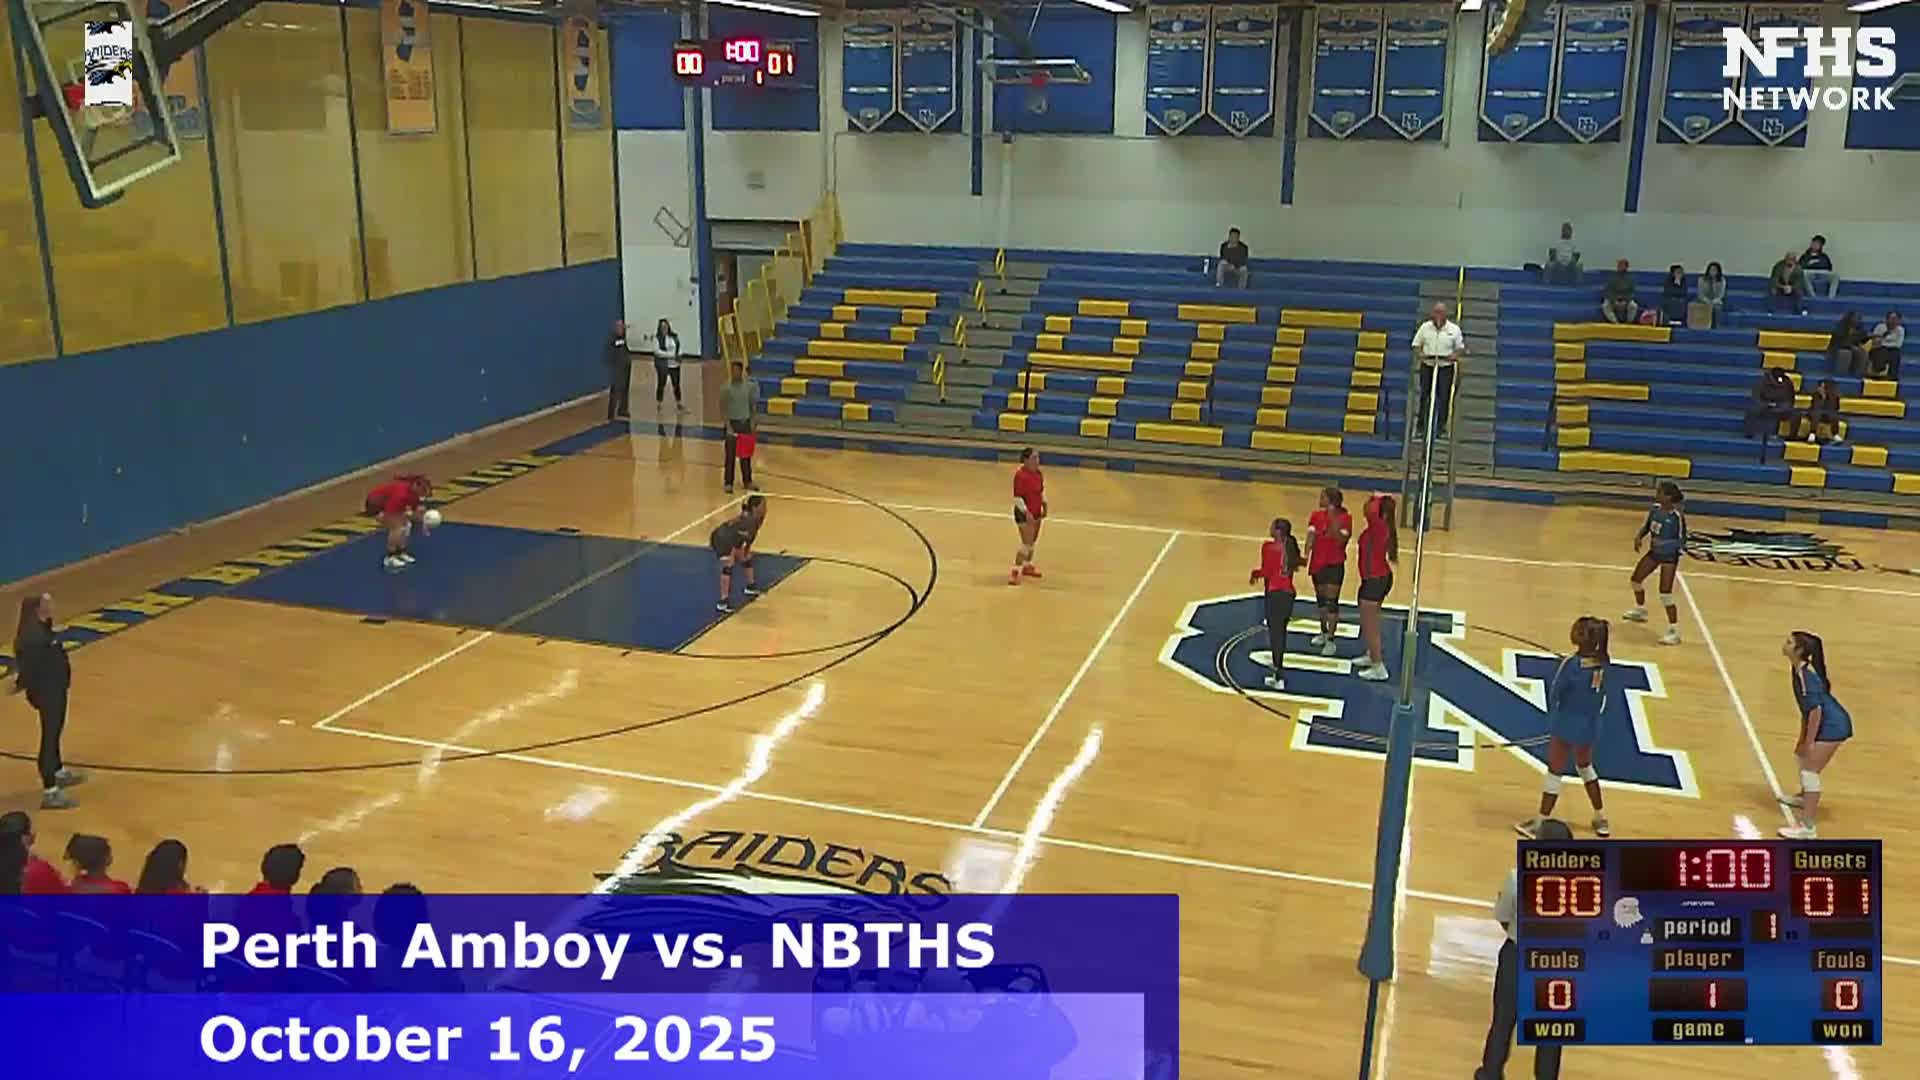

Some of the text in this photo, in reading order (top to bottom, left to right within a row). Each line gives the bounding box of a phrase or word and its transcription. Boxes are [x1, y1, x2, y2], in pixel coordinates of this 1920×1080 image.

[726, 40, 759, 62] 1:00
[676, 52, 703, 75] 00
[767, 53, 793, 75] 01
[1525, 850, 1601, 869] Raiders
[1679, 849, 1771, 888] 1:00
[1794, 851, 1867, 869] Guests
[622, 831, 952, 912] RAIDERS
[1535, 876, 1601, 917] 00
[1804, 876, 1869, 916] 01
[1664, 918, 1731, 939] period
[1769, 912, 1777, 939] 1
[1664, 950, 1732, 970] player
[1548, 980, 1572, 1010] 0
[1709, 982, 1717, 1008] 1
[1835, 981, 1858, 1010] 0
[1535, 1023, 1576, 1037] won
[1673, 1022, 1725, 1039] game
[1823, 1024, 1863, 1038] won
